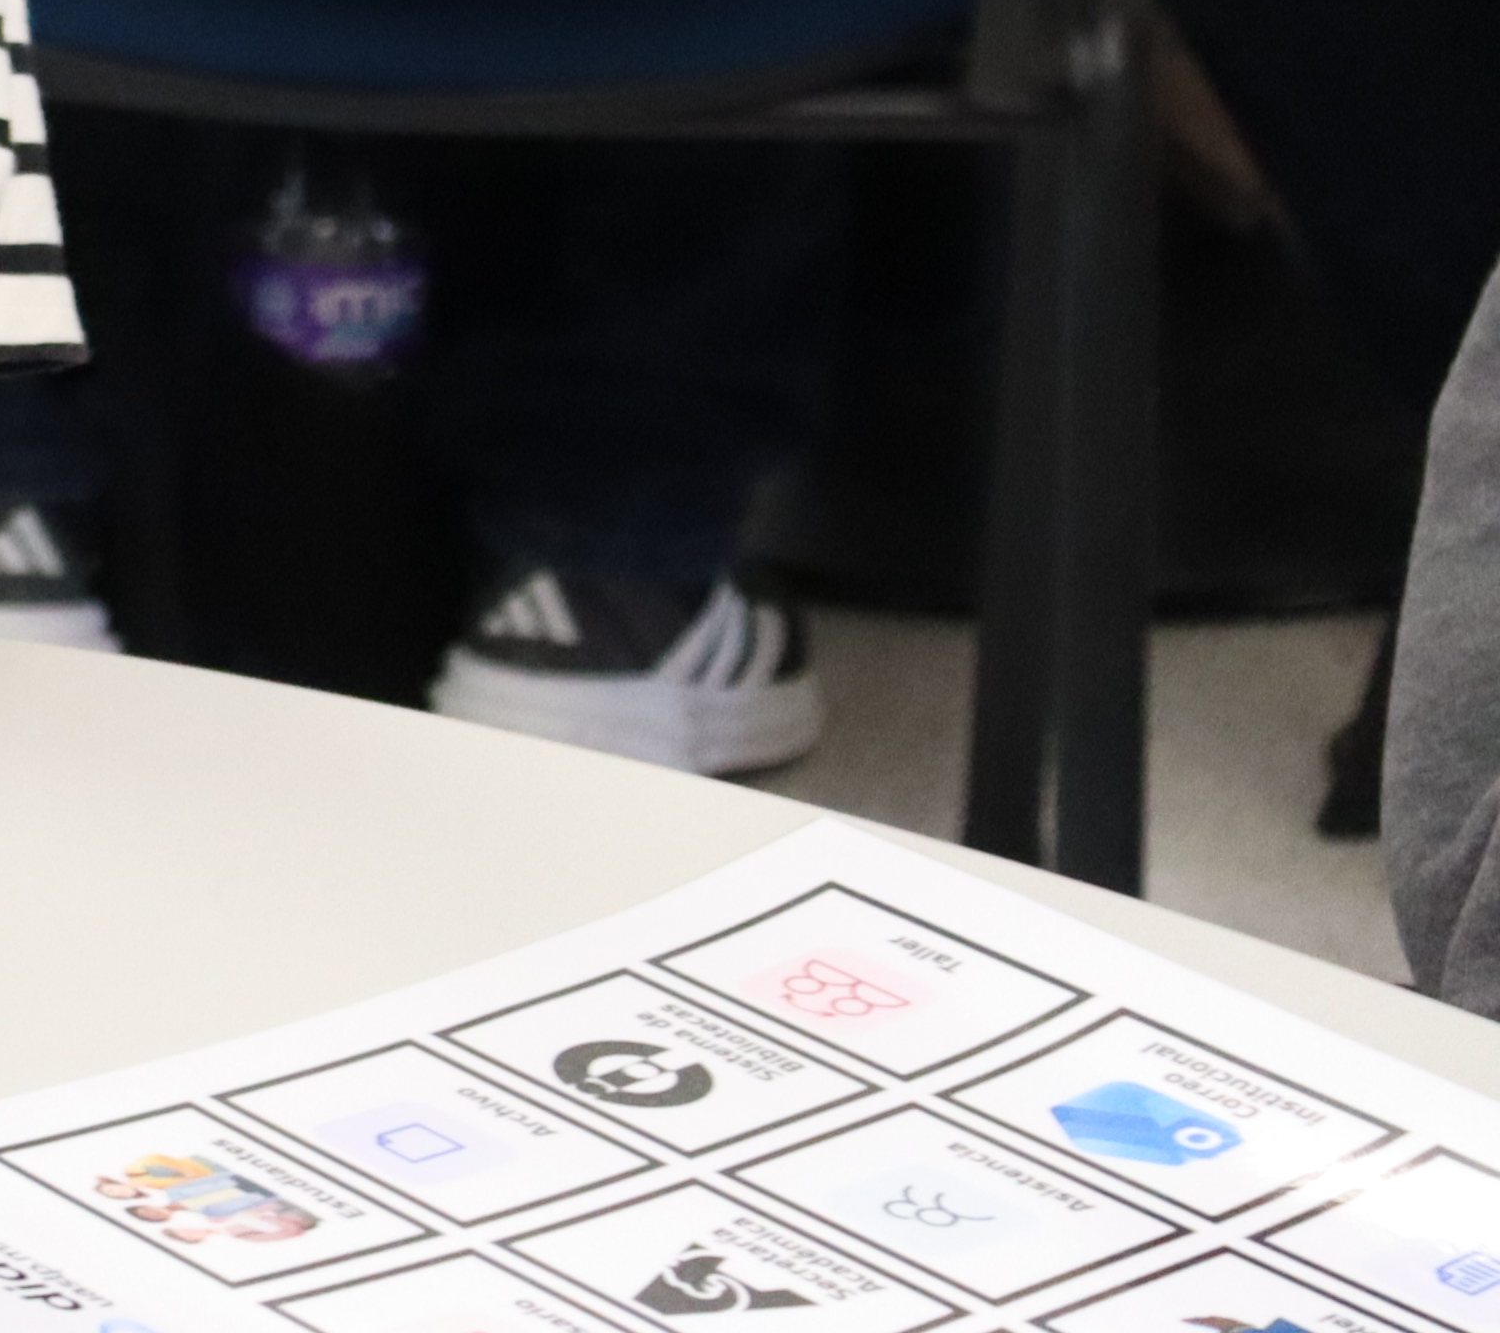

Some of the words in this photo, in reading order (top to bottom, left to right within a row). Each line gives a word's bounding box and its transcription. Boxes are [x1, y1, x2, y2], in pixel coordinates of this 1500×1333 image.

[887, 935, 964, 974] Taller
[635, 1009, 671, 1034] de
[658, 1002, 805, 1074] Bibliotecas
[671, 1026, 782, 1083] Sistema
[455, 1086, 556, 1138] Archivo
[1162, 1070, 1262, 1122] Correo
[209, 1136, 365, 1221] Estudiantes
[945, 1140, 1094, 1214] Asistencia
